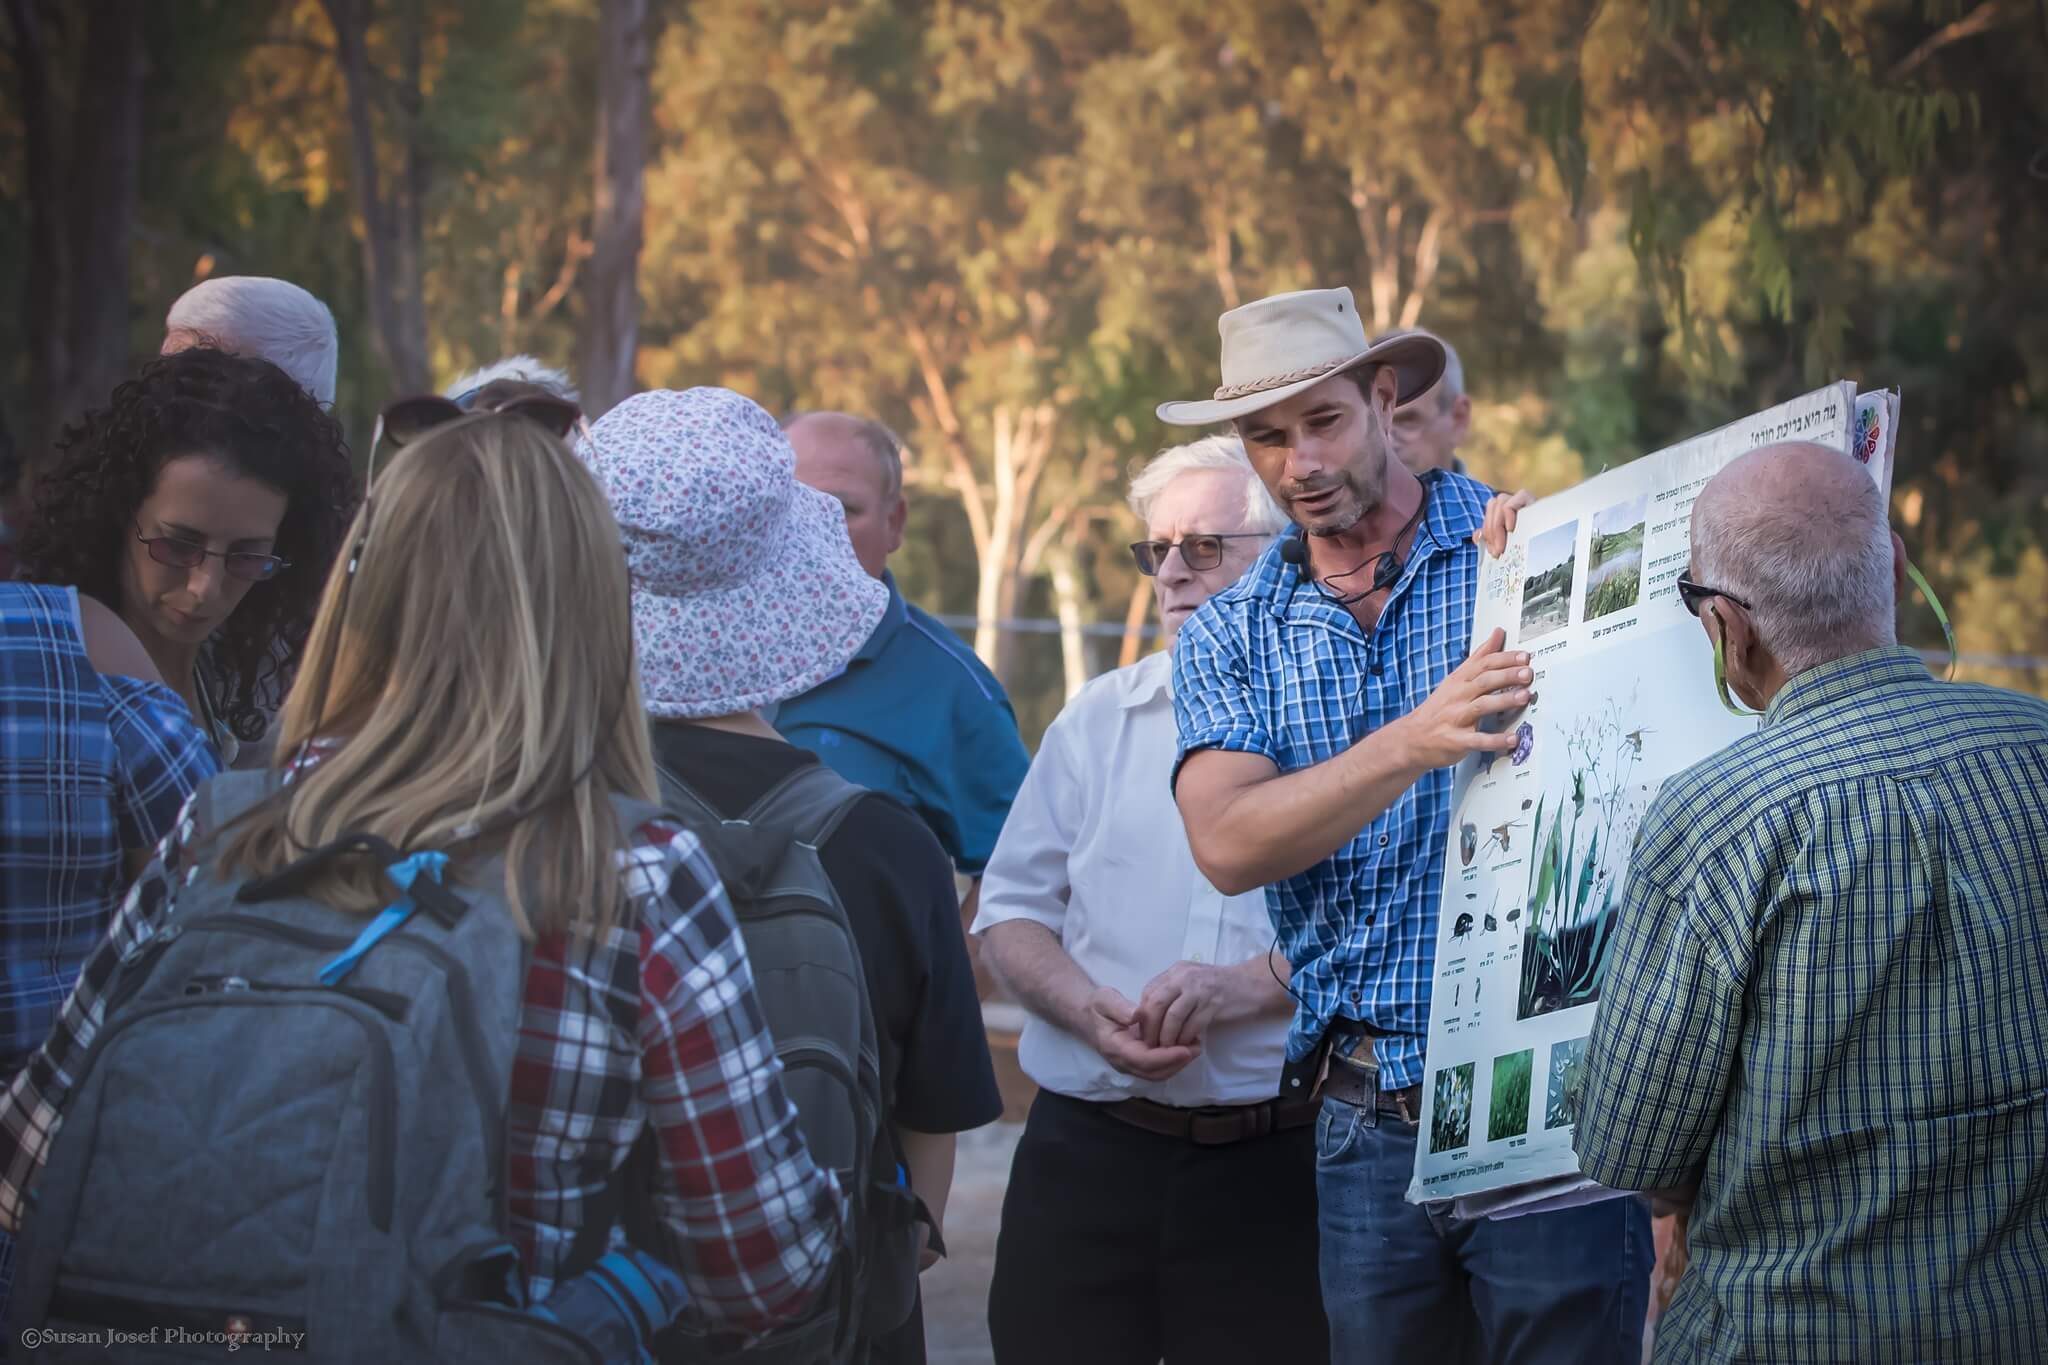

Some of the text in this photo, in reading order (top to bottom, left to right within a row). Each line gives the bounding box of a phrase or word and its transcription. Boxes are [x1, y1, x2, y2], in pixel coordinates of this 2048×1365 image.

[1804, 408, 1821, 429] היא
[1823, 404, 1836, 421] מה
[1776, 417, 1802, 440] בריכת
